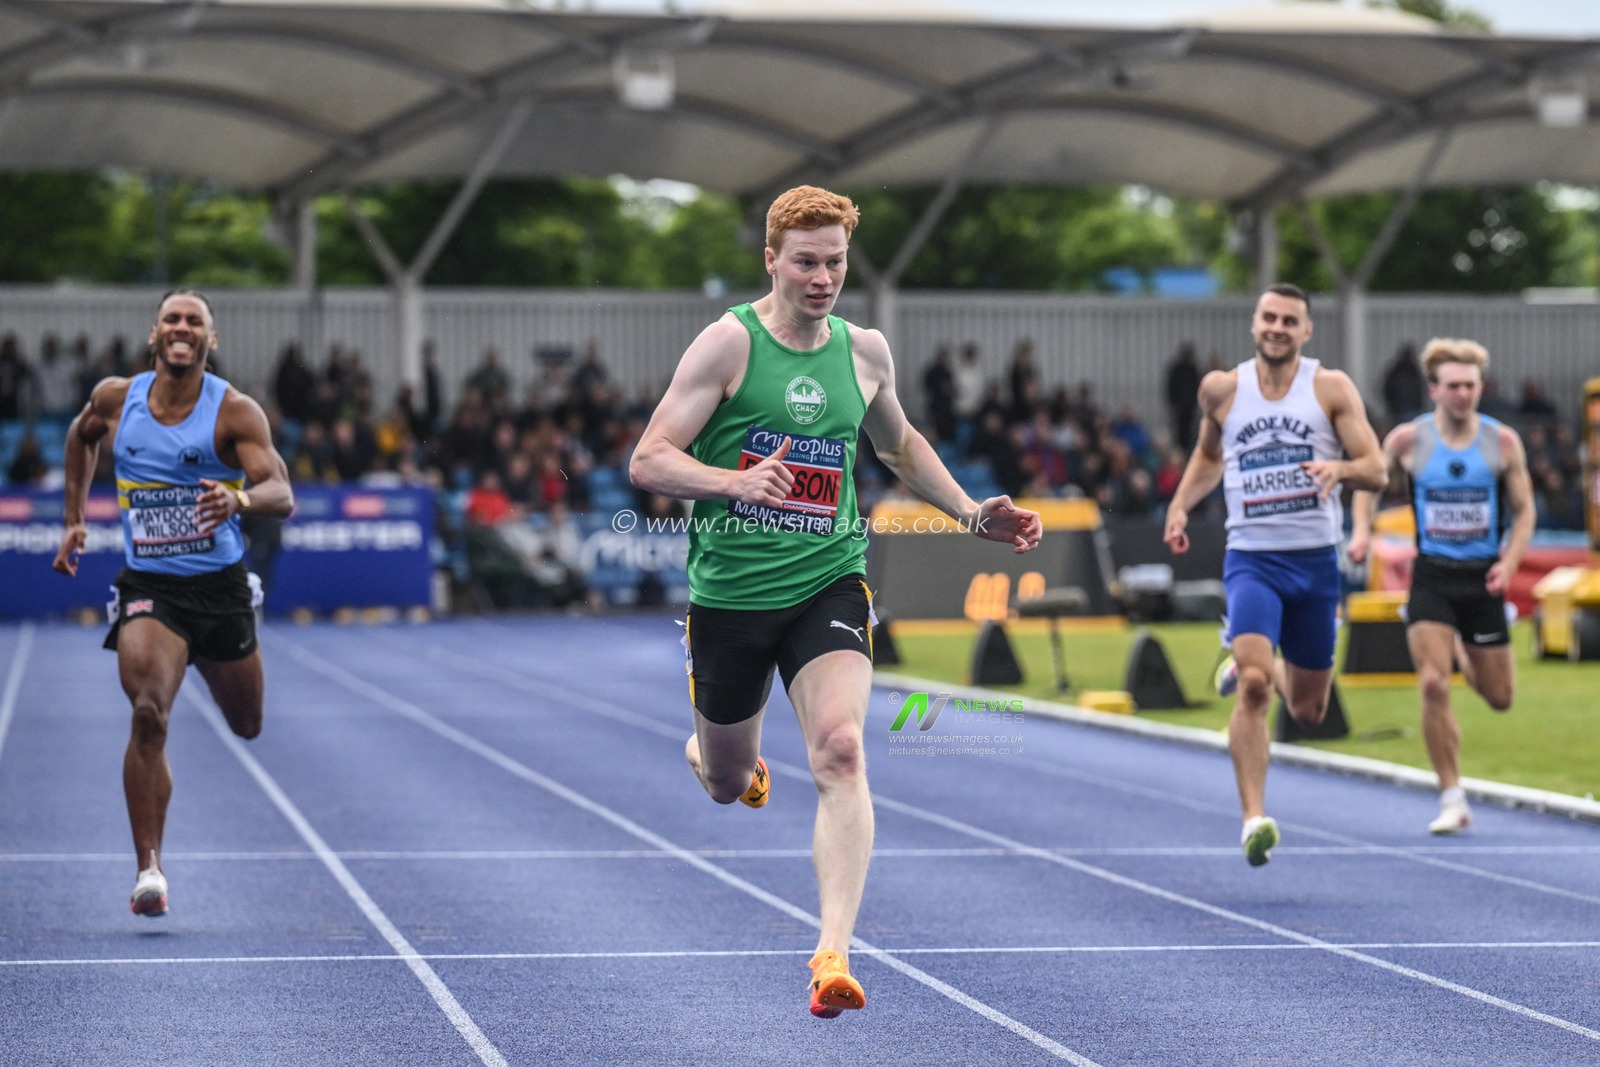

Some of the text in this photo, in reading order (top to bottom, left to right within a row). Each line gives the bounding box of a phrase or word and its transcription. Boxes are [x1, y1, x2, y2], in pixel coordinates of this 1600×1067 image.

[795, 404, 816, 413] CHAC
[1236, 415, 1315, 445] PHOENIX
[752, 431, 842, 463] Miroplus
[752, 443, 770, 453] DATA
[771, 448, 811, 461] PESSING
[819, 456, 839, 464] TIMING
[1242, 468, 1313, 495] HARRIES
[734, 501, 831, 532] MANCHESTER
[783, 503, 832, 515] CHAMPIONSHIPS
[145, 522, 200, 538] WILSON
[136, 539, 211, 557] MANCHESTER
